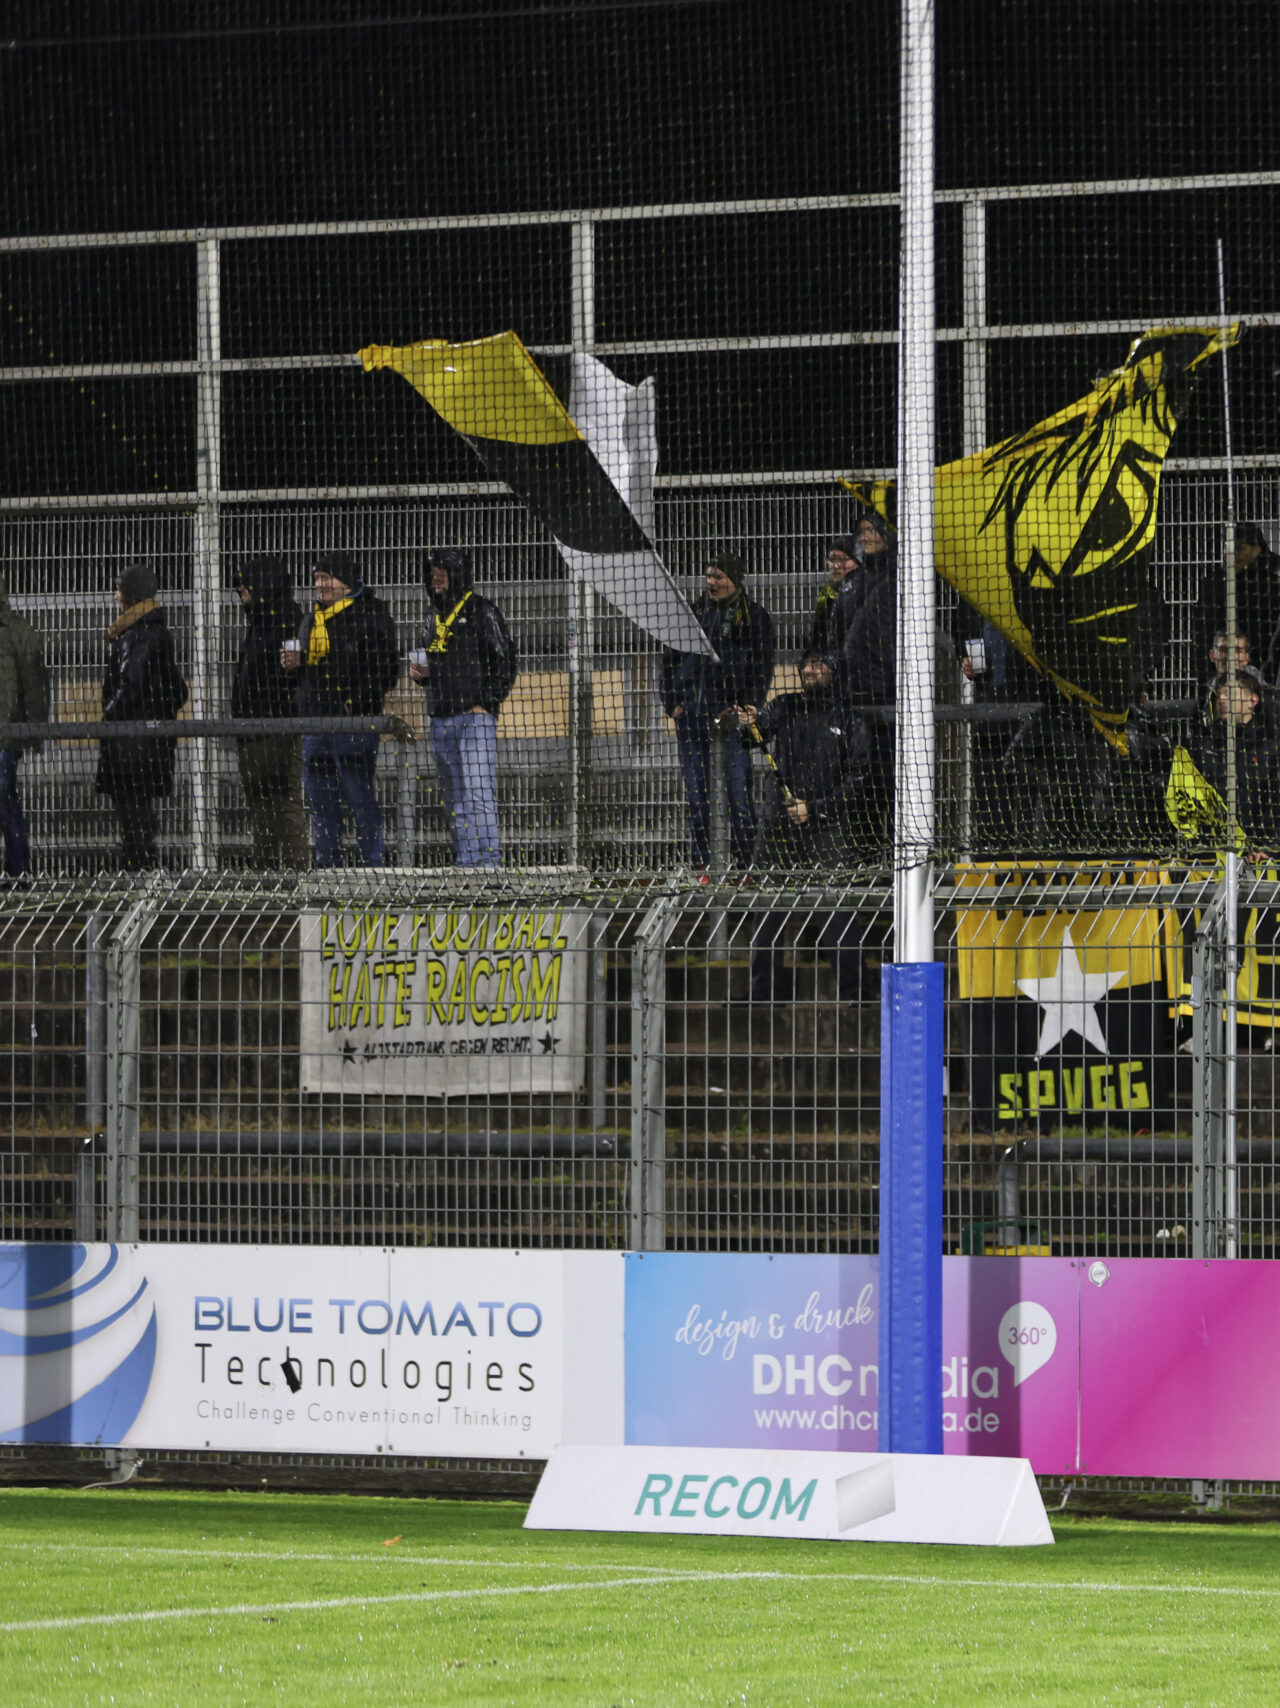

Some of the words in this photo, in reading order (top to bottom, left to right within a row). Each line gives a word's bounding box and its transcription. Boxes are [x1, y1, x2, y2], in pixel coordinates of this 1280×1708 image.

[321, 906, 399, 960] LOVE
[411, 905, 568, 955] FOOTBALL
[328, 960, 416, 1031] HATE
[426, 953, 563, 1026] RACISM
[999, 1061, 1150, 1120] SPVGG
[194, 1296, 313, 1333] BLUE
[328, 1299, 543, 1338] TOMATO
[675, 1304, 762, 1360] design
[768, 1313, 786, 1339] &
[794, 1283, 875, 1334] druck
[1008, 1327, 1047, 1345] 360°
[194, 1343, 535, 1402] Technologies
[196, 1399, 296, 1425] Challenge
[307, 1402, 442, 1425] Conventional
[453, 1406, 533, 1431] Thinking
[634, 1473, 818, 1522] RECOM
